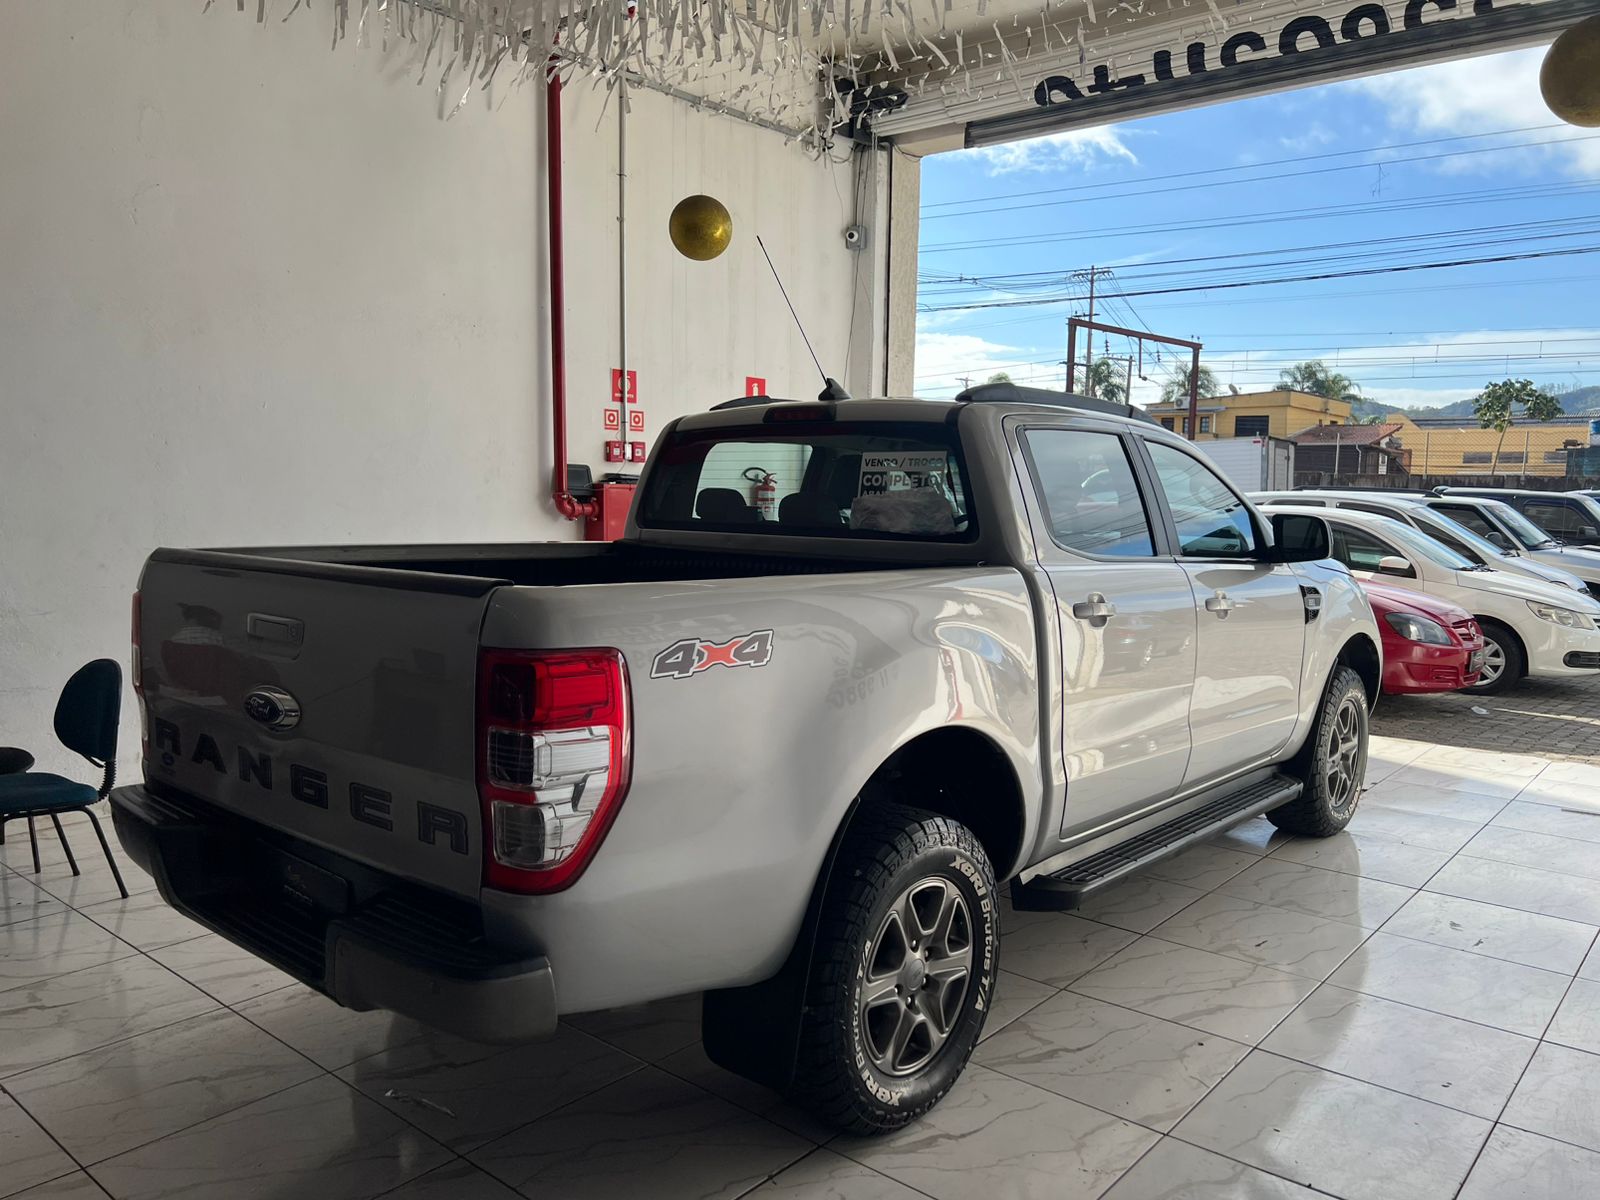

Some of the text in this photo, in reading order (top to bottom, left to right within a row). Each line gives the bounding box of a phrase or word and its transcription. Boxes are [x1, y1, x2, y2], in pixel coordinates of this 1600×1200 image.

[864, 458, 898, 467] VENDO
[155, 717, 469, 856] RANGER
[949, 854, 994, 1011] XBRI Brutus T/A
[852, 987, 865, 1068] Brutus
[861, 1068, 902, 1106] XBRI
